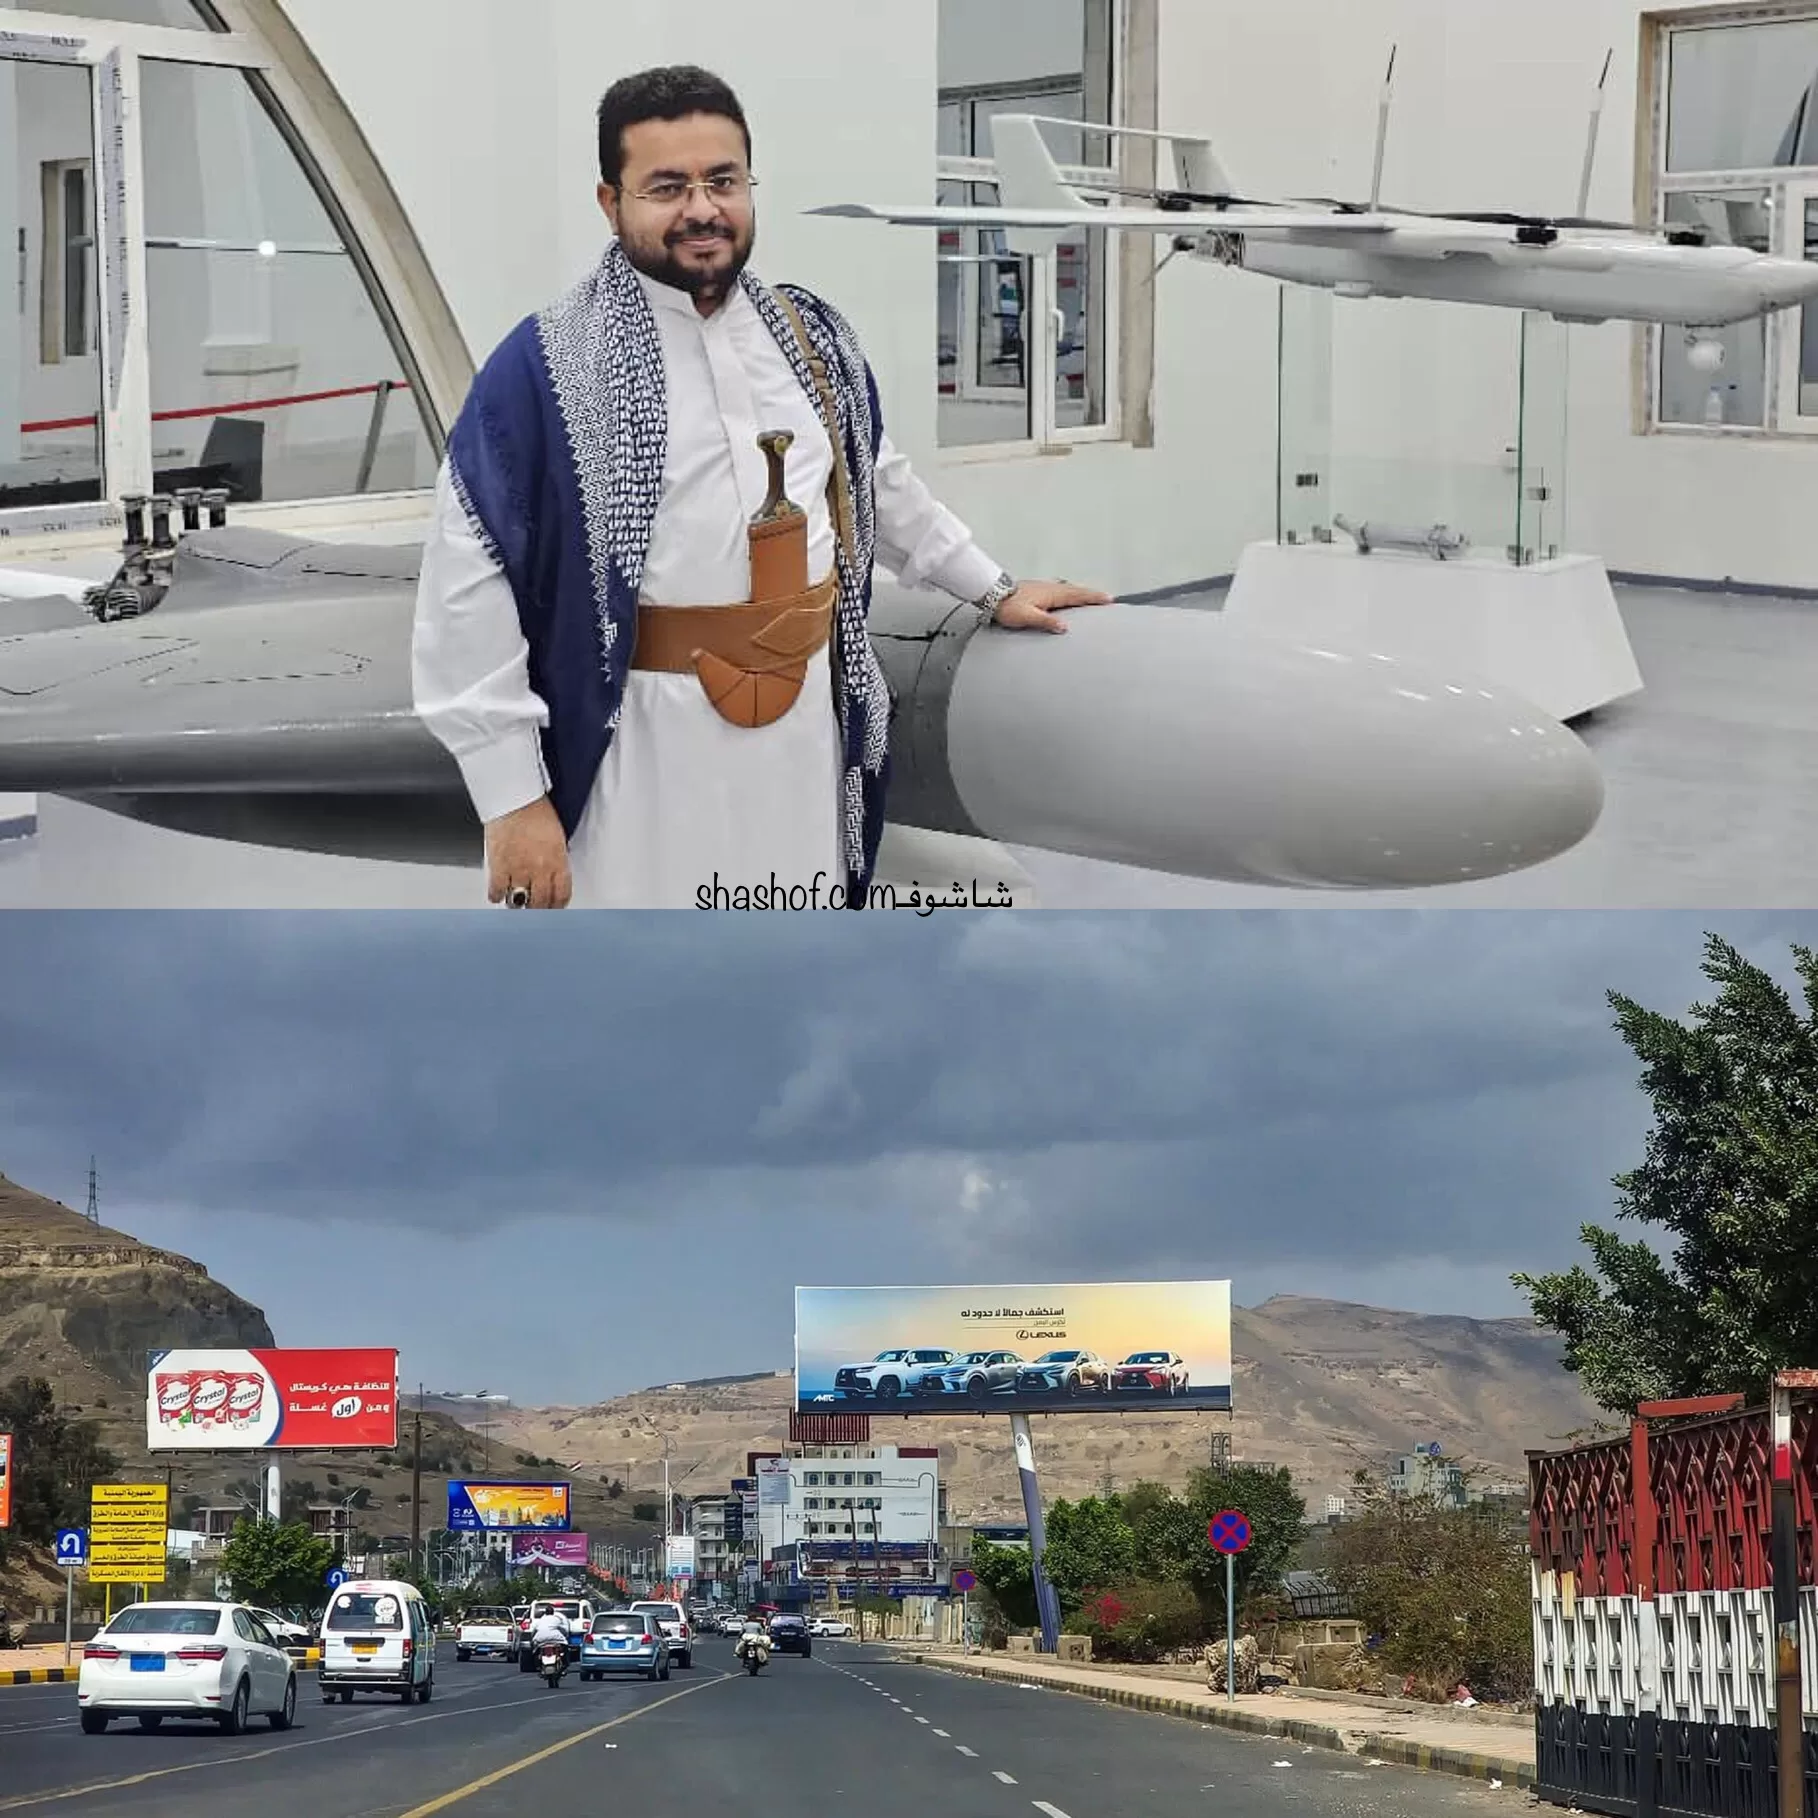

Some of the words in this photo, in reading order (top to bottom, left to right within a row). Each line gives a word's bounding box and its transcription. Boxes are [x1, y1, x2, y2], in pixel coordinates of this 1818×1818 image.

[961, 1309, 970, 1317] له
[972, 1309, 993, 1319] حدود
[1025, 1307, 1064, 1317] استكشف
[1030, 1331, 1067, 1339] LEXUS
[289, 1382, 327, 1393] كريستال
[329, 1384, 352, 1394] هي
[193, 1388, 225, 1406] Crystal
[229, 1389, 259, 1406] Crystal
